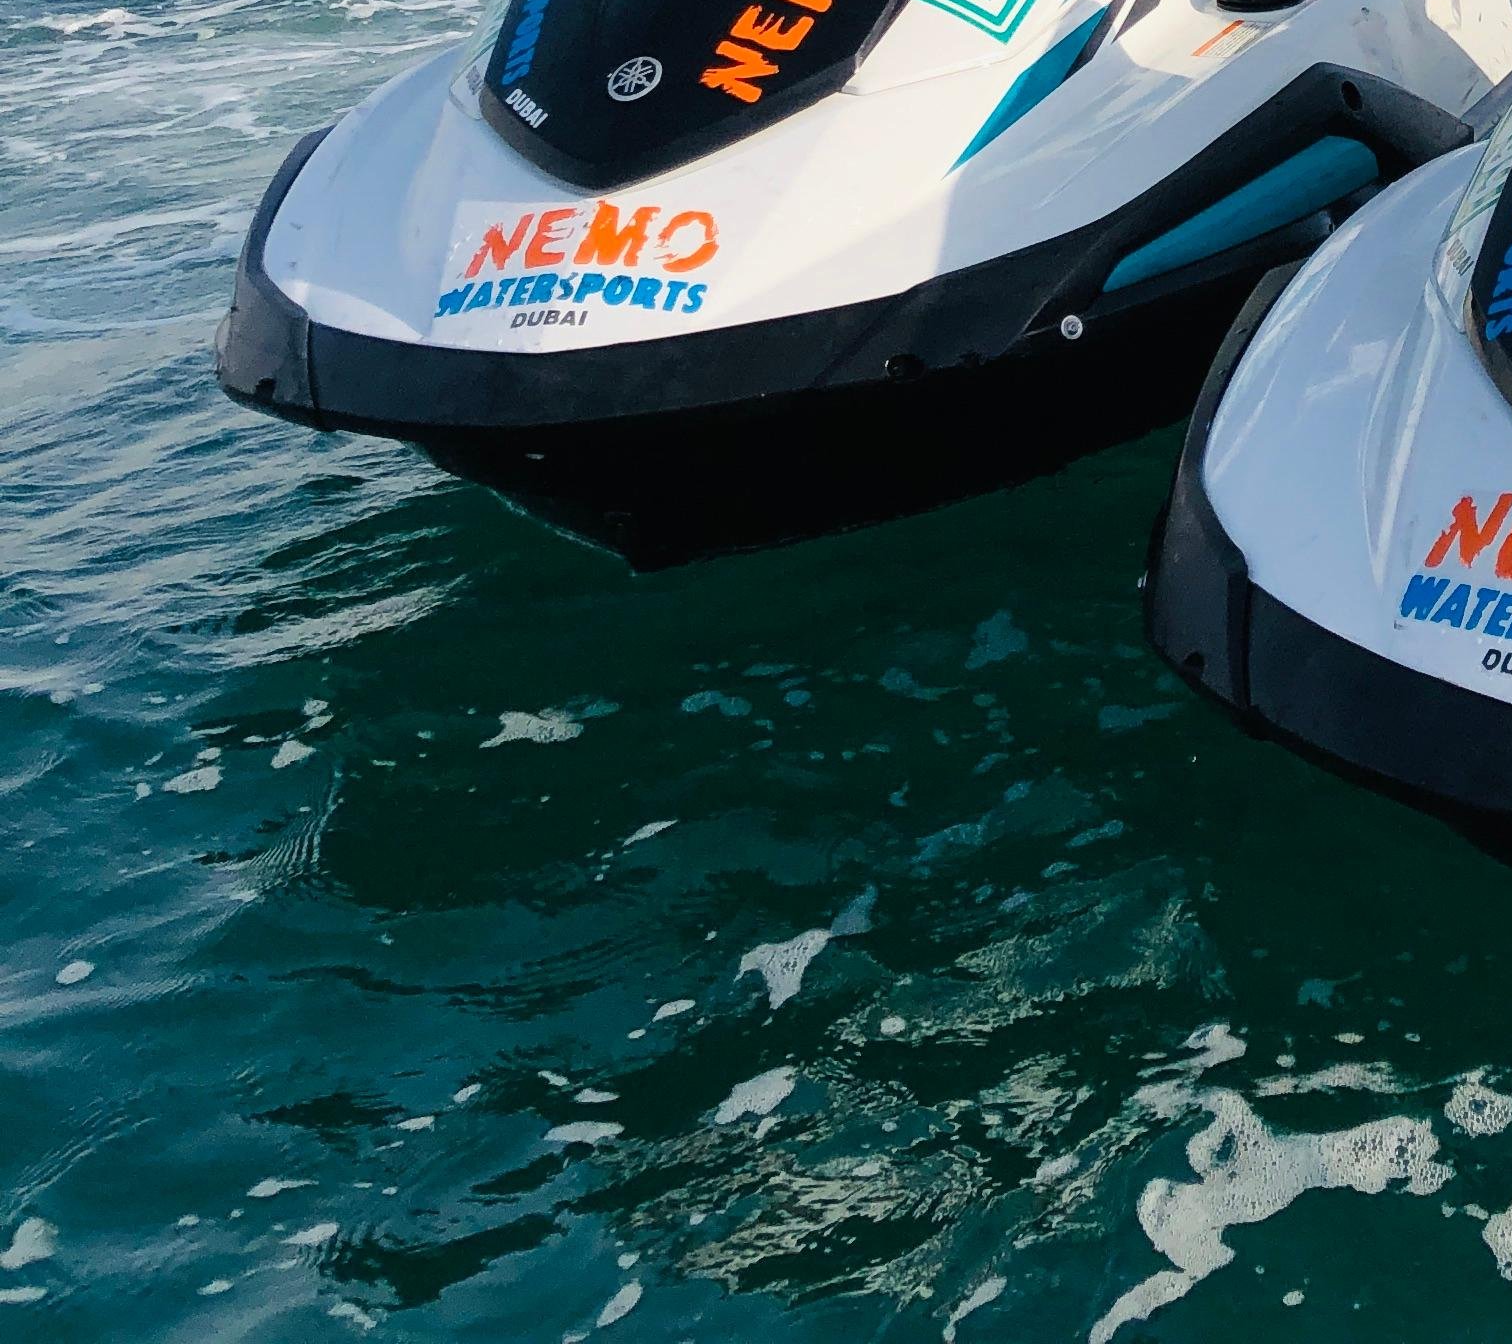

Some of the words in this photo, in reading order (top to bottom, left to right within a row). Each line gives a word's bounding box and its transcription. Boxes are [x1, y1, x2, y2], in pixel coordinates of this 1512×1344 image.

[505, 88, 549, 129] DUBAI
[458, 200, 720, 280] NEMO
[434, 271, 708, 315] WATERSPORTS
[510, 309, 589, 329] DUBAI
